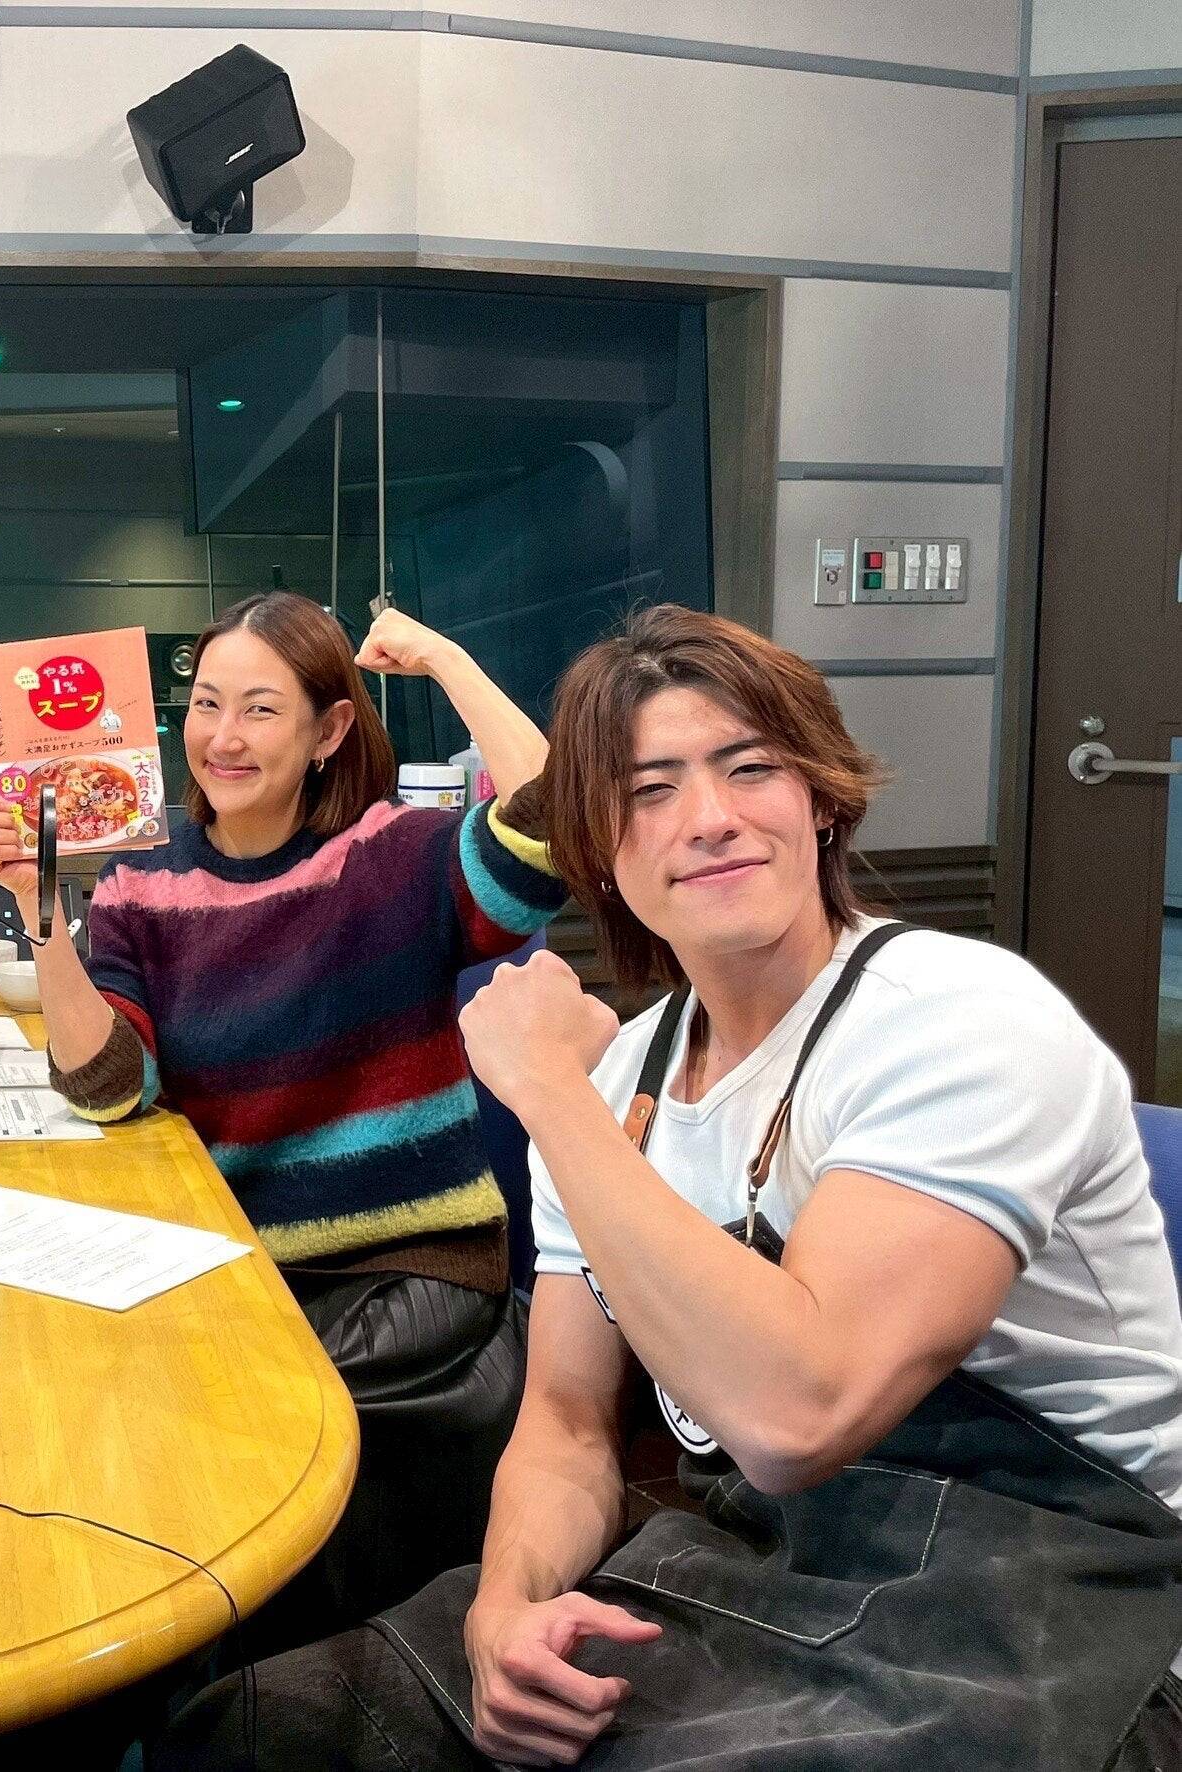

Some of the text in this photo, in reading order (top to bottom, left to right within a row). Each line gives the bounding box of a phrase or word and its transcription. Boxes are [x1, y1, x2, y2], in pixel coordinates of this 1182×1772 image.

[43, 662, 85, 677] やる気
[52, 679, 78, 695] 1%
[37, 691, 102, 717] スープ
[134, 761, 154, 817] 大賞2冠
